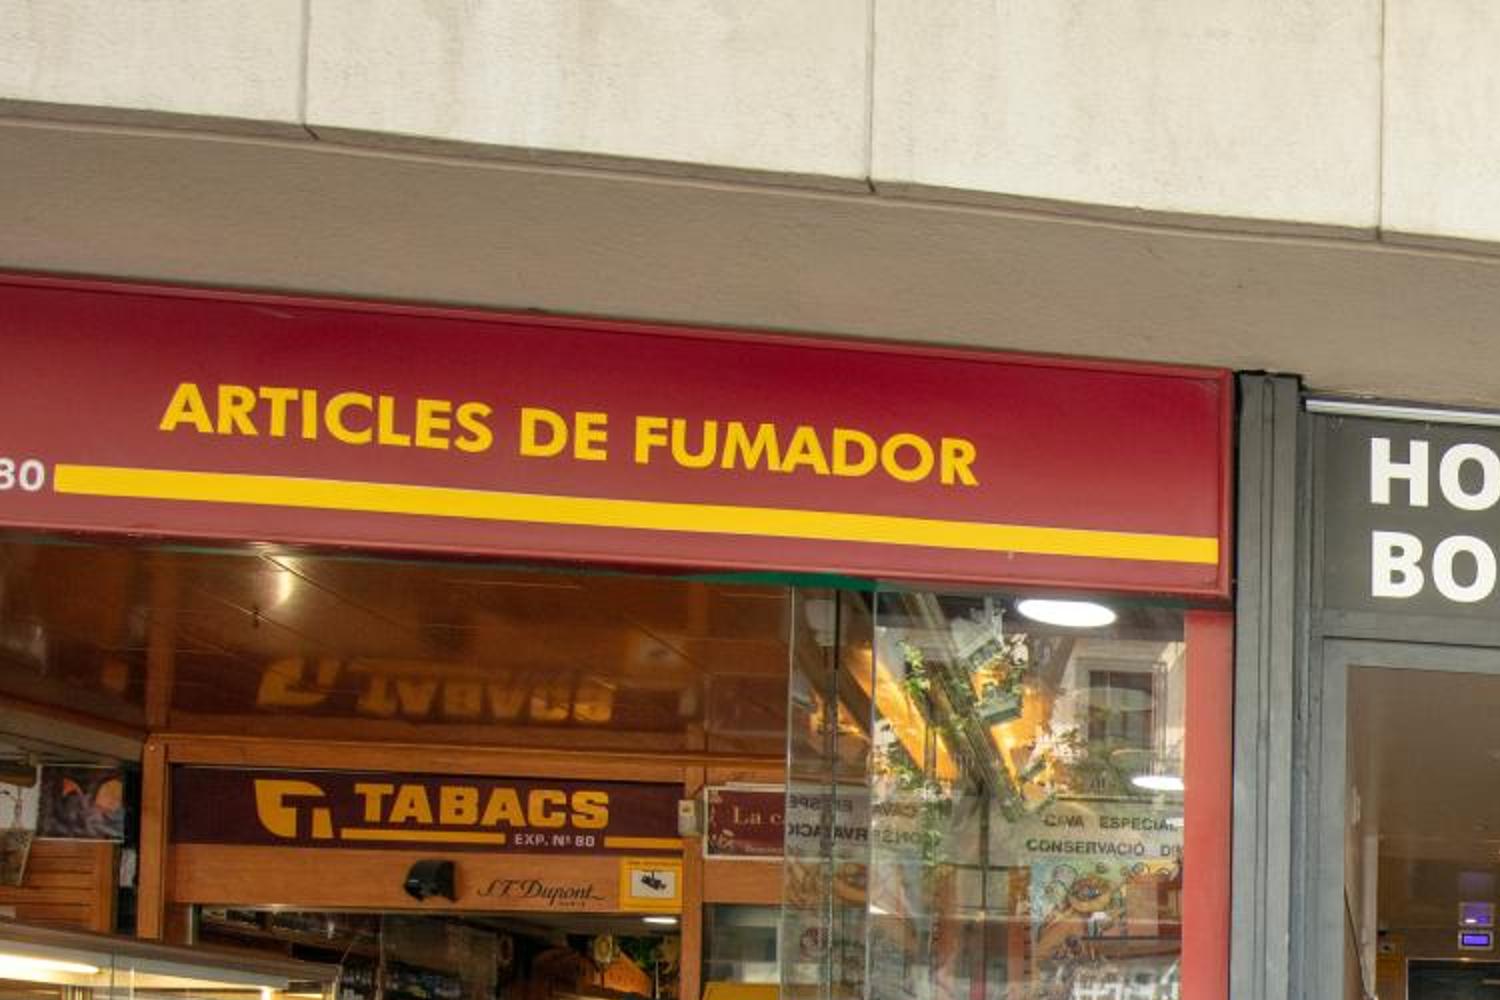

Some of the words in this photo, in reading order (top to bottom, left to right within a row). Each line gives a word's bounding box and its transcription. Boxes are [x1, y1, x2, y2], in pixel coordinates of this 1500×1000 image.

[159, 382, 494, 453] ARTICLES
[519, 407, 609, 462] DE
[634, 415, 979, 487] FUMADOR
[354, 782, 610, 830] TABACS
[514, 833, 549, 847] EXP.
